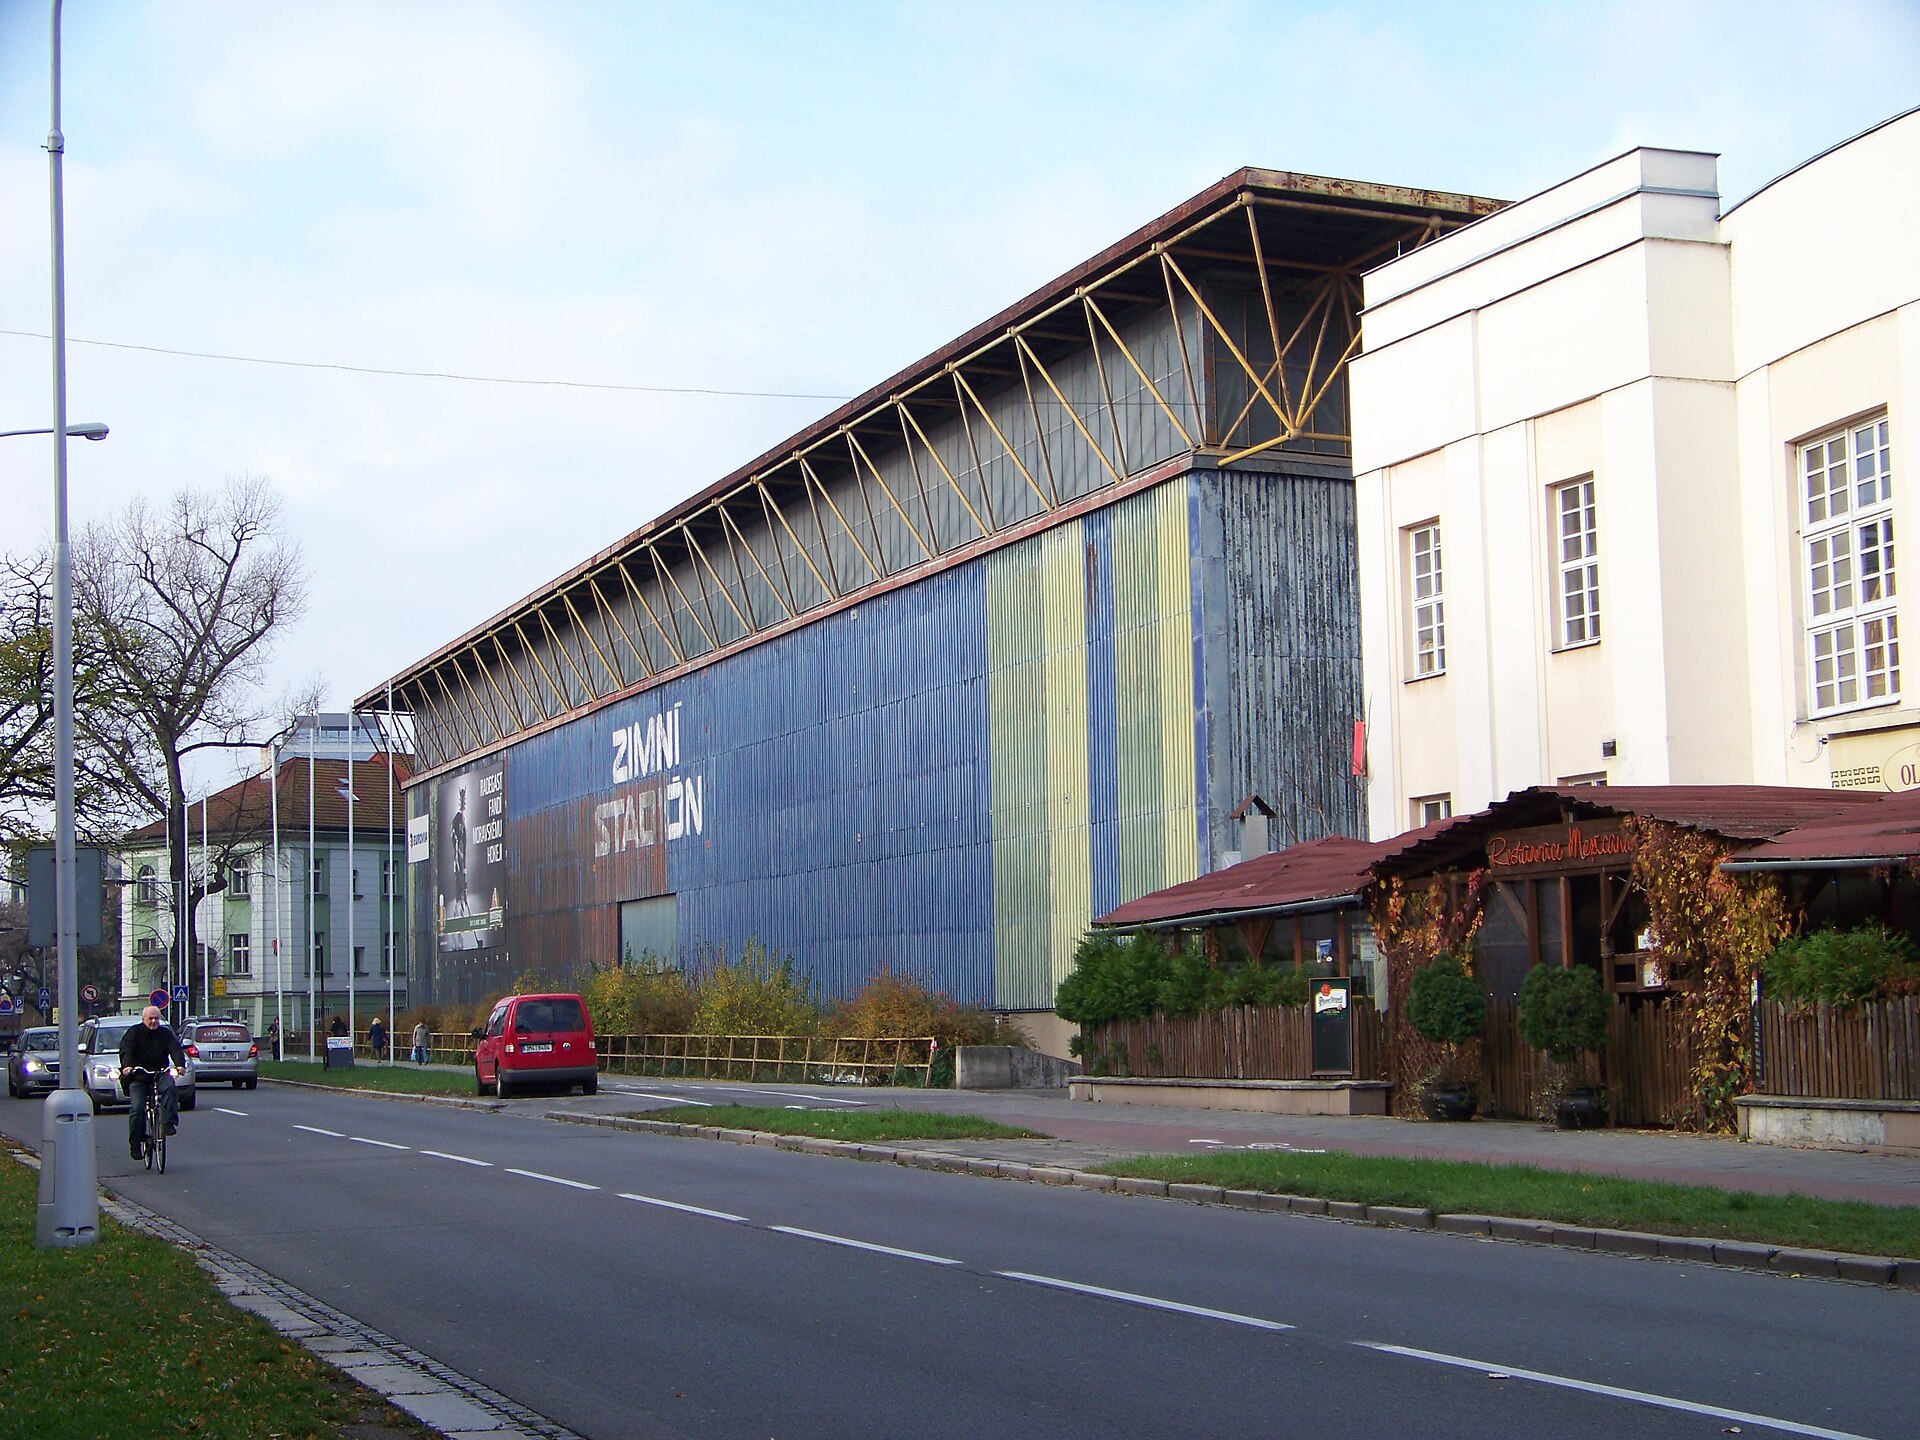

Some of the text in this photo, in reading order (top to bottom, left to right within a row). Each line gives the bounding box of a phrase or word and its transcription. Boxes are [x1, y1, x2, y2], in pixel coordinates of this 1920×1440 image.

[612, 700, 683, 784] ZIMNÍ
[480, 771, 503, 797] RADEGAST
[595, 775, 703, 857] STADIÓN
